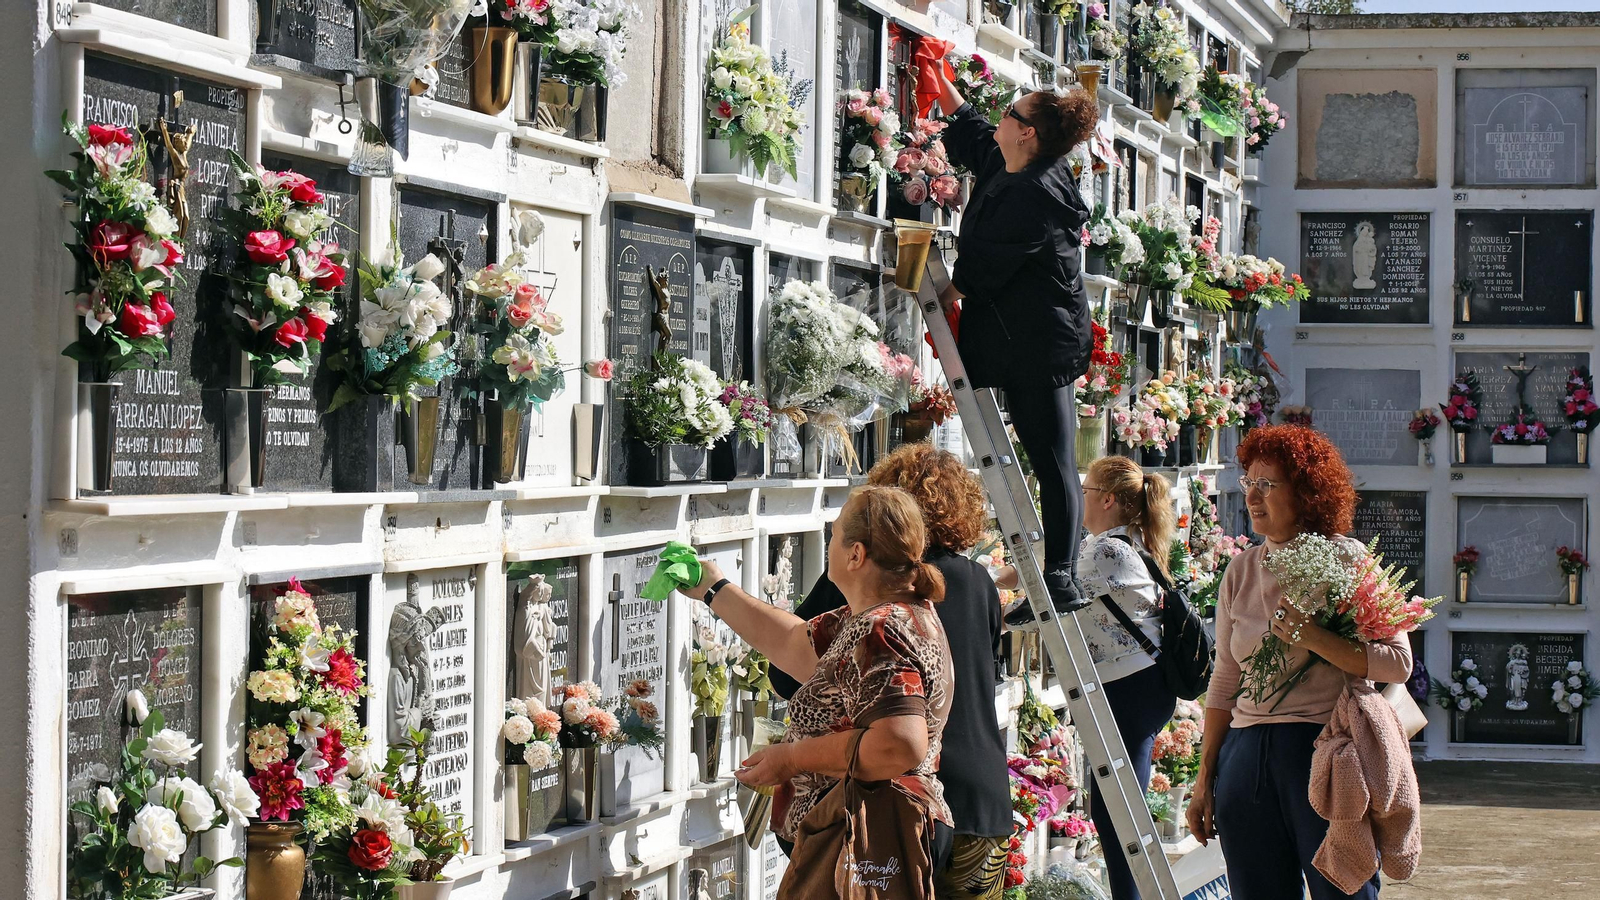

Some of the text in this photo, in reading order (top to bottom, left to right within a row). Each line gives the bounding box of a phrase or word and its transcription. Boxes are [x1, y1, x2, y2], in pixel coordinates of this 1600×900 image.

[1457, 53, 1470, 61] 956
[197, 158, 229, 187] LOPEZ
[1453, 193, 1467, 201] 957
[1470, 236, 1511, 244] CONSUELO
[1330, 250, 1347, 258] AÑOS
[1468, 245, 1512, 253] MARTINEZ
[1473, 254, 1508, 263] VICENTE
[135, 369, 180, 395] MANUEL
[277, 385, 310, 400] HERMANOS
[116, 403, 203, 429] ARRAGAN LOPEZ
[268, 408, 317, 423] RINOS Y PRIMOS
[115, 433, 203, 453] 15-4-1975 A LOS 12 AÑOS
[273, 431, 310, 447] TE OLVIDAN
[112, 460, 199, 477] NUNCA OS OLVIDAREMOS
[432, 578, 466, 600] DOLORES
[153, 628, 195, 650] DOLORES
[68, 638, 109, 661] RONIMO
[1538, 645, 1573, 654] BRIGIDA
[157, 657, 190, 678] GOMEZ
[1536, 666, 1566, 675] JIMEN
[68, 670, 99, 691] PARRA
[154, 684, 193, 707] MORENO
[67, 699, 100, 721] GOMEZ
[850, 873, 893, 891] Moment
